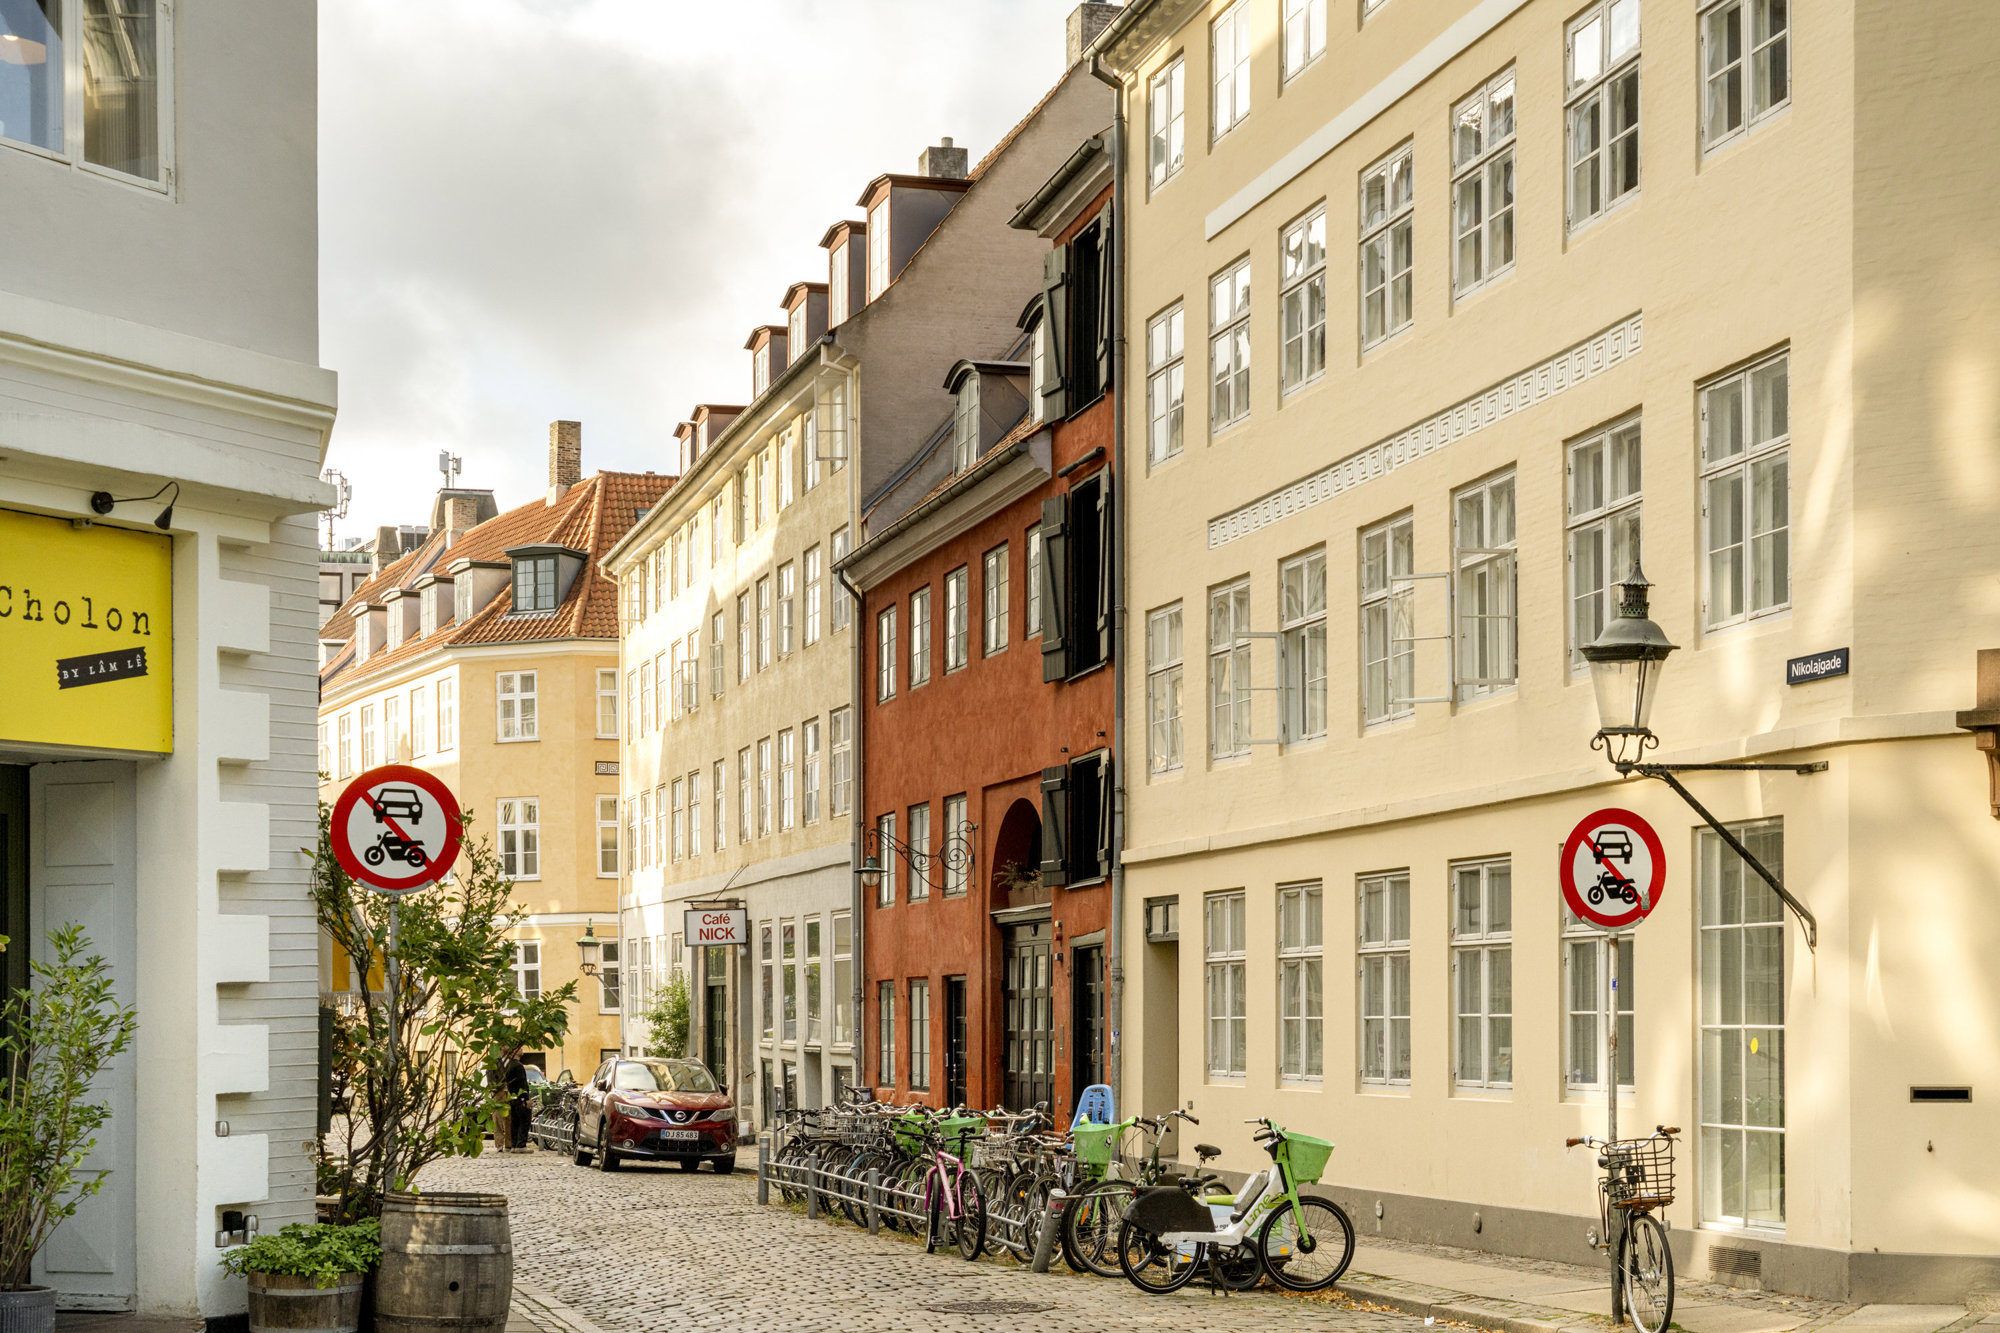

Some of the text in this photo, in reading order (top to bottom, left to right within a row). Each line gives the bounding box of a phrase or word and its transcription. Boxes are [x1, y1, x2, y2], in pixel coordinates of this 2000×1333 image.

[0, 585, 151, 635] Cholon
[62, 654, 142, 679] BY LÂM LÊ
[1791, 655, 1841, 677] Nikolajgade
[702, 913, 731, 925] Café
[699, 926, 736, 940] NICK
[1244, 1194, 1271, 1227] Lime
